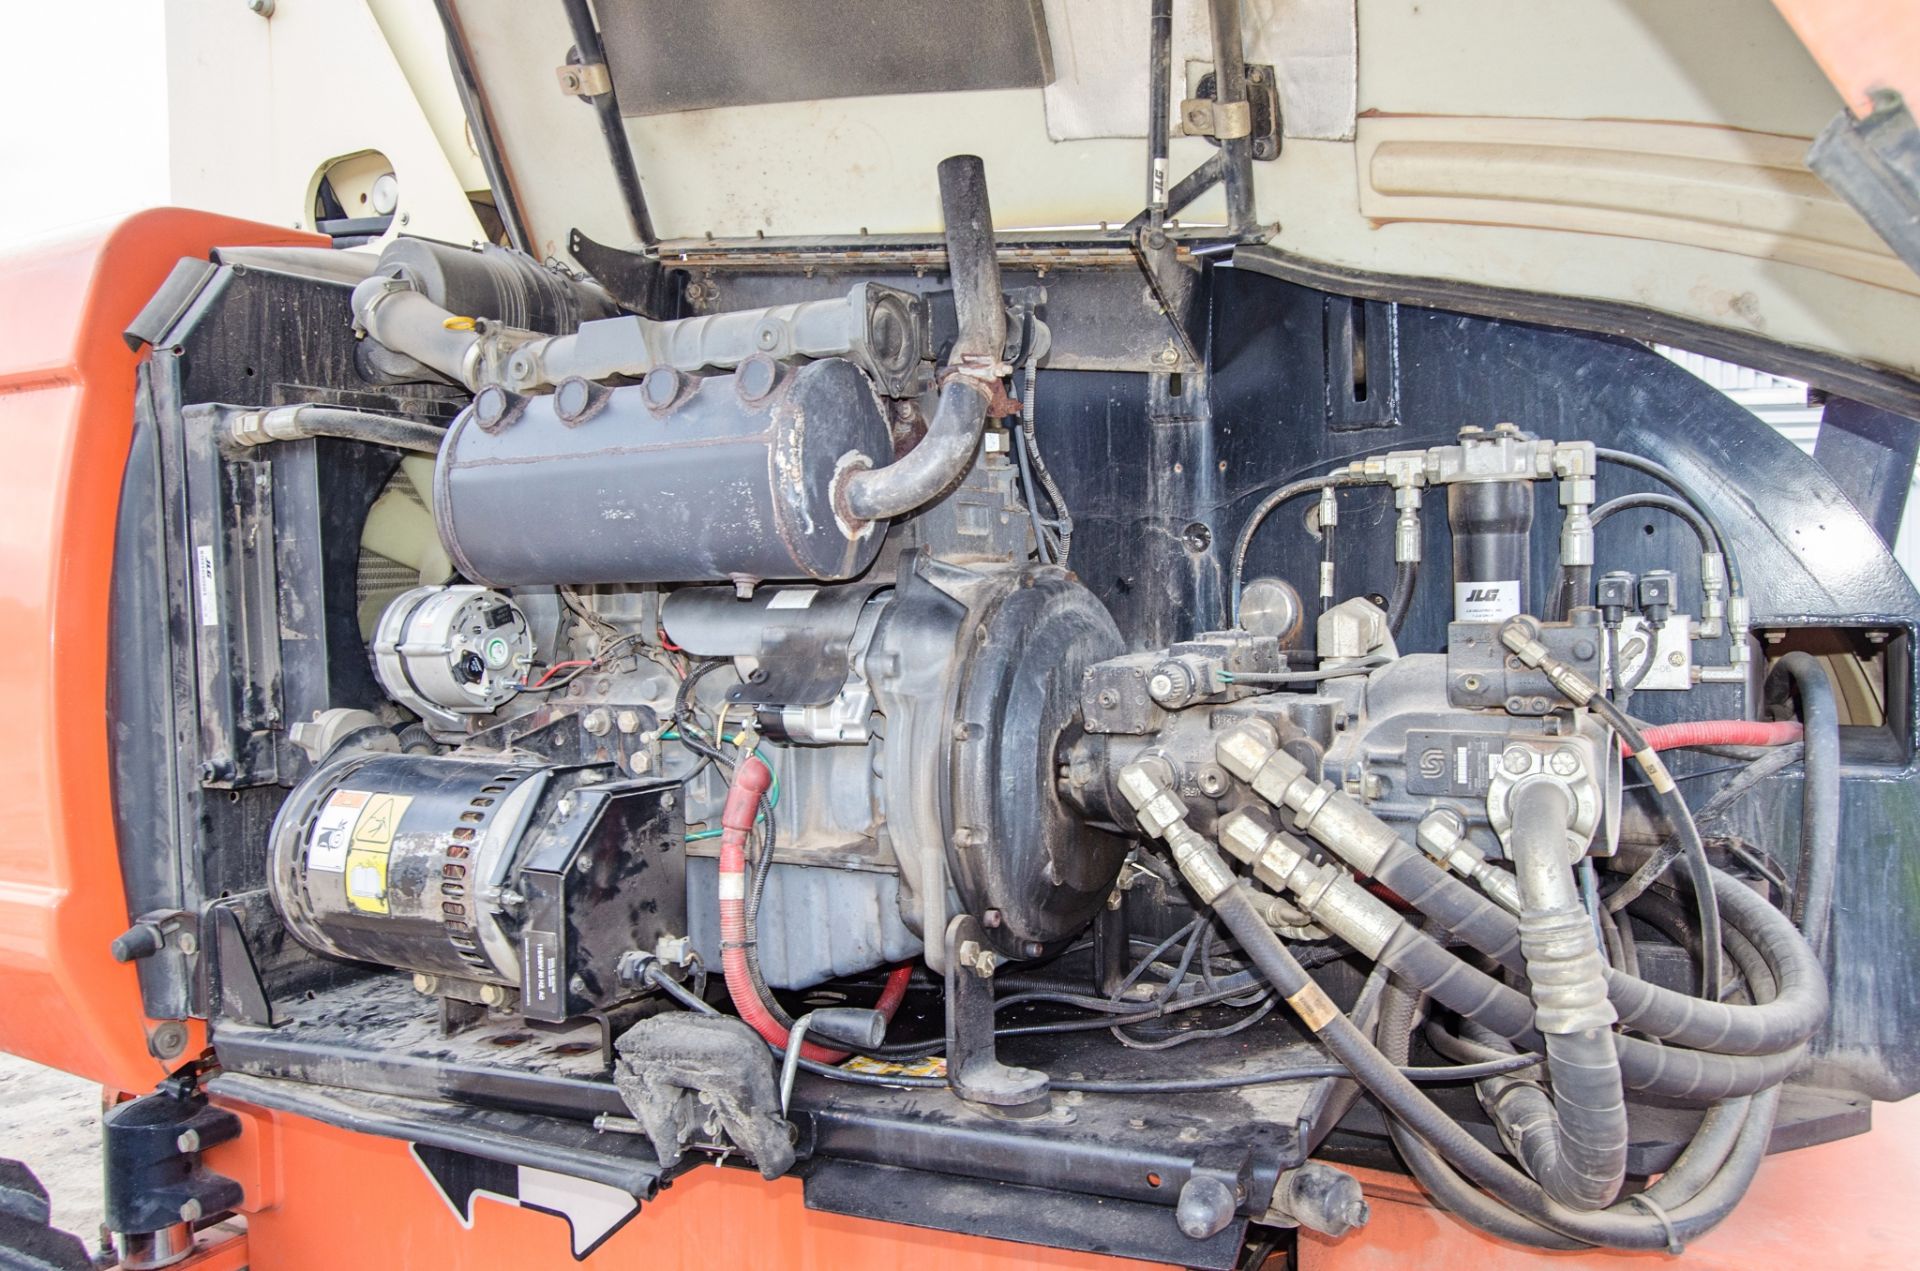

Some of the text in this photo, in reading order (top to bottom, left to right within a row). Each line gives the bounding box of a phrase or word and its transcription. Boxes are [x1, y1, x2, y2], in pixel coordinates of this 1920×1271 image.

[1155, 168, 1164, 195] JLG
[1465, 588, 1500, 602] JLG
[538, 990, 546, 1001] AC
